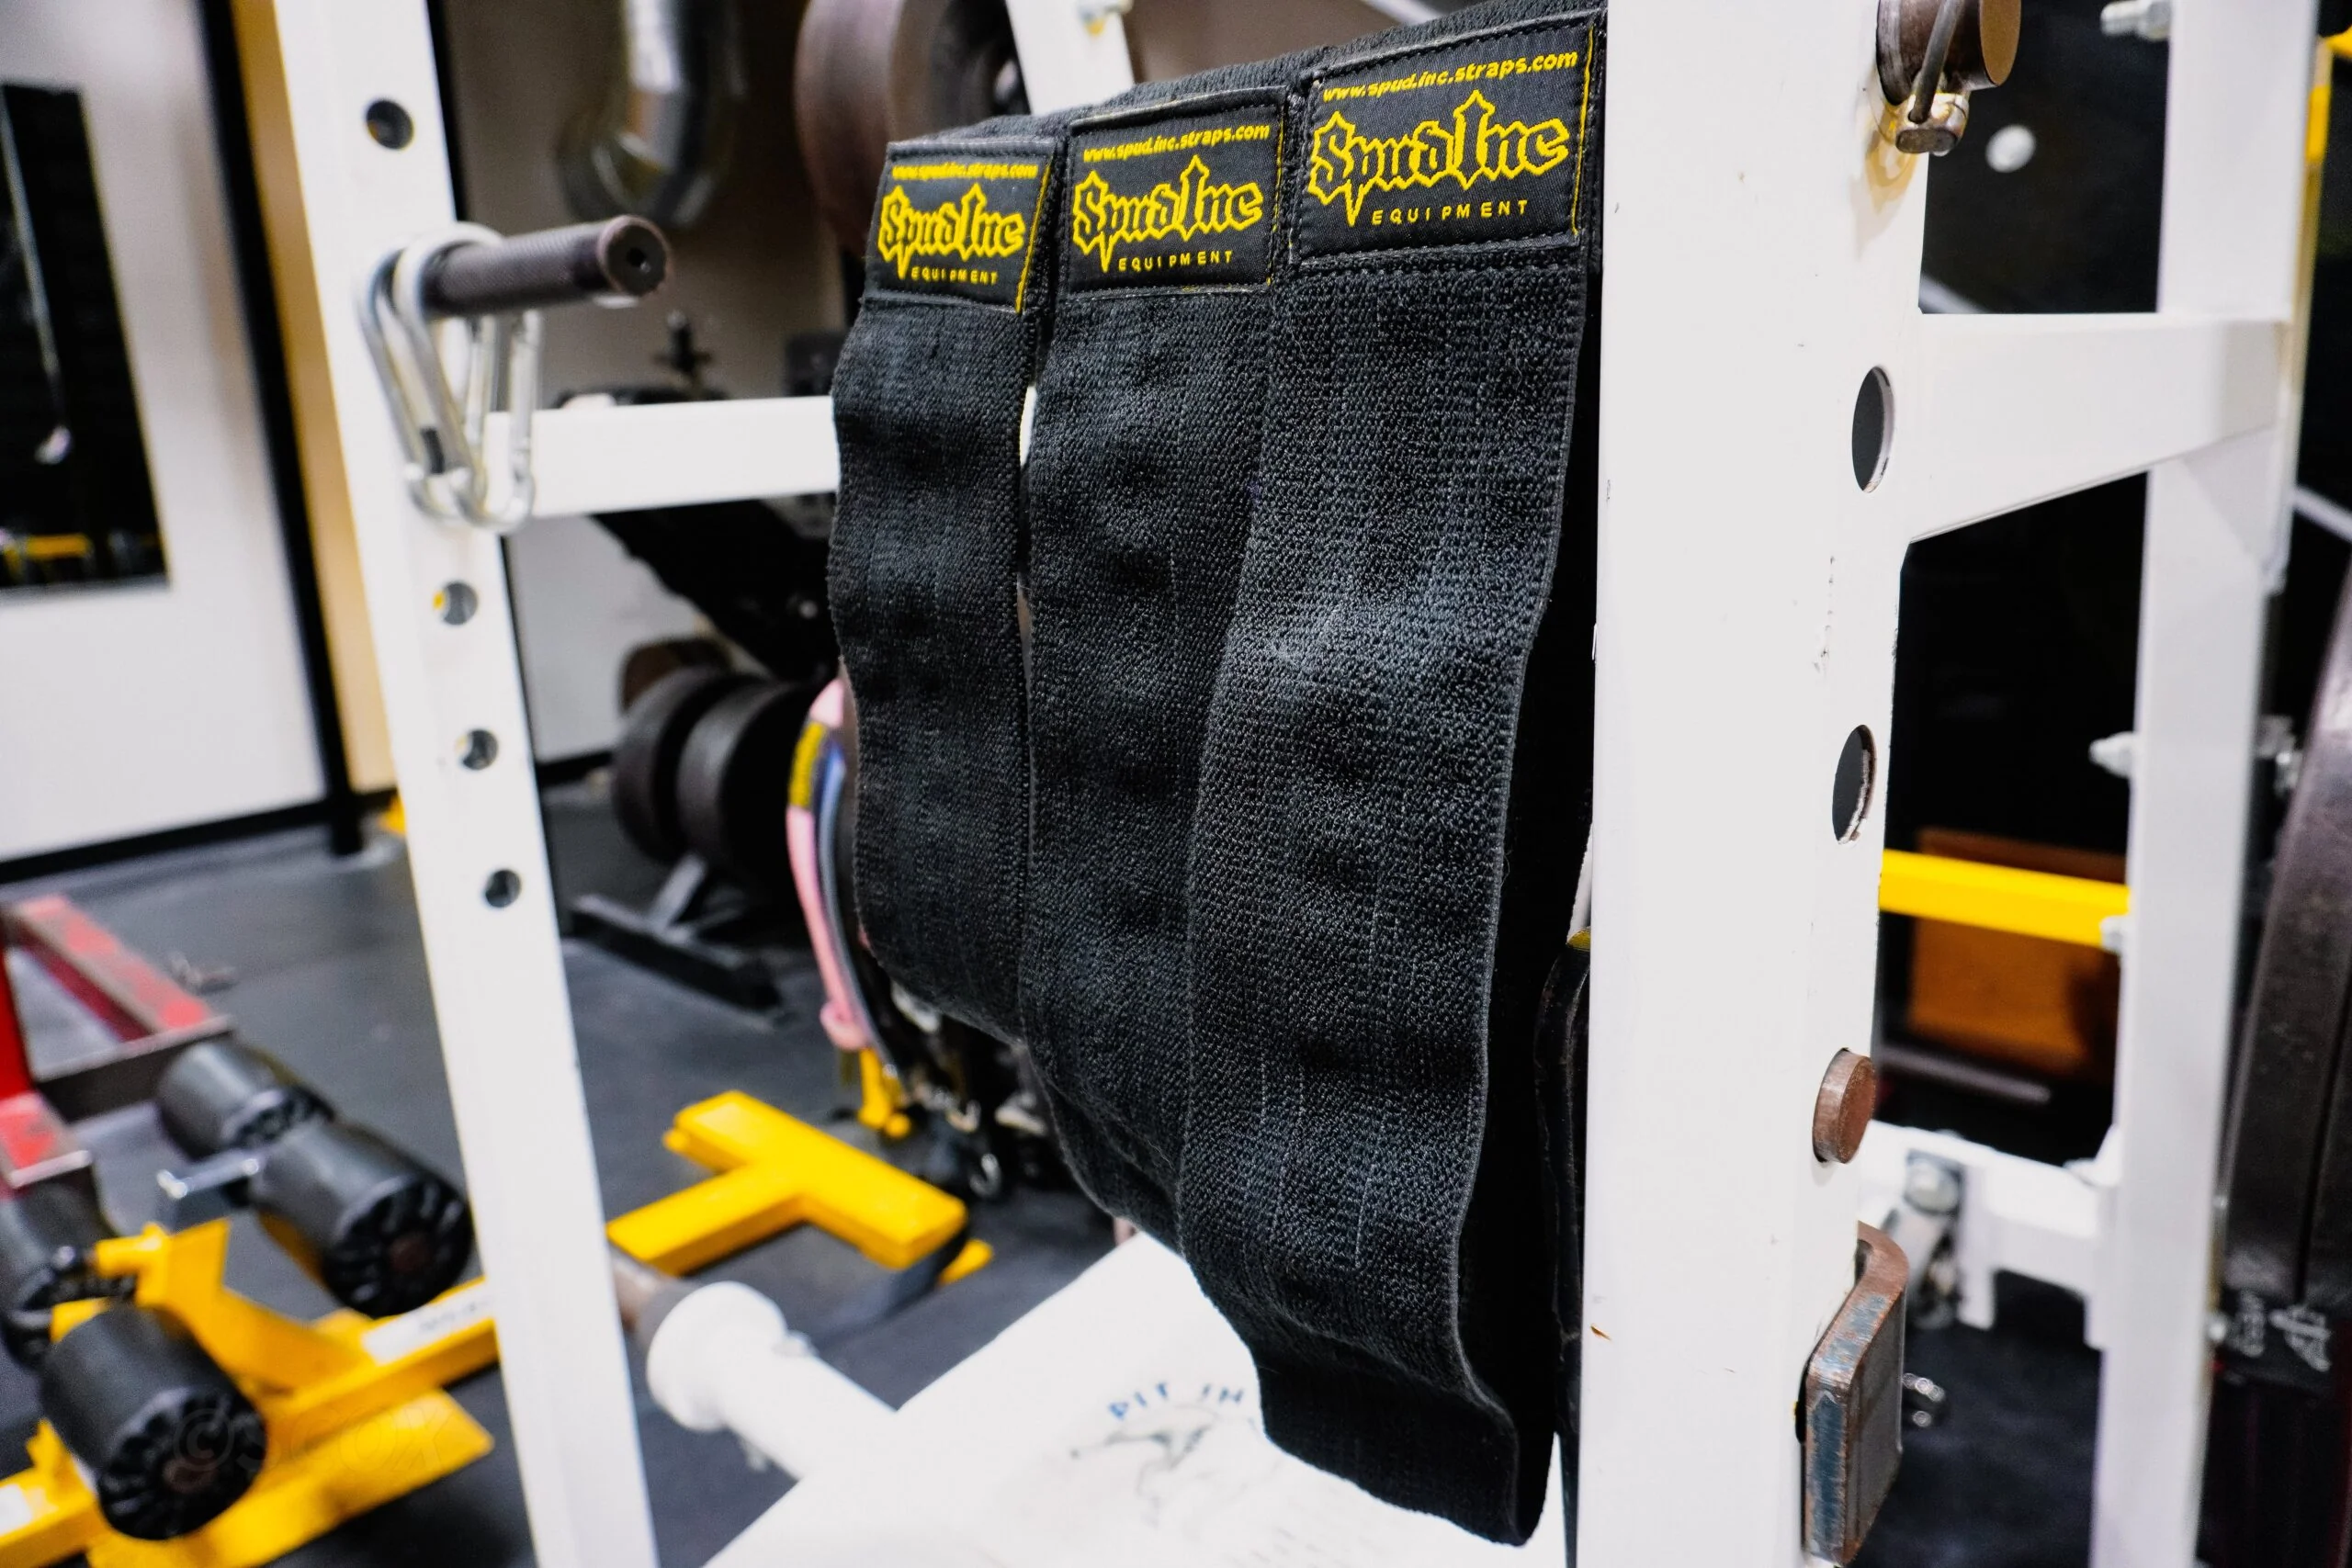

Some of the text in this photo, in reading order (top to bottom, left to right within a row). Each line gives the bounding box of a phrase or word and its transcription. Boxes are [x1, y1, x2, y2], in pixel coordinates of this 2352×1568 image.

[1322, 51, 1578, 103] www.spud.inc.straps.com
[1082, 124, 1271, 163] www.spud.inc.straps.com
[1371, 199, 1528, 226] EQUIPMENT
[910, 265, 998, 285] EQUIPMENT
[1118, 250, 1233, 273] EQUIPMENT
